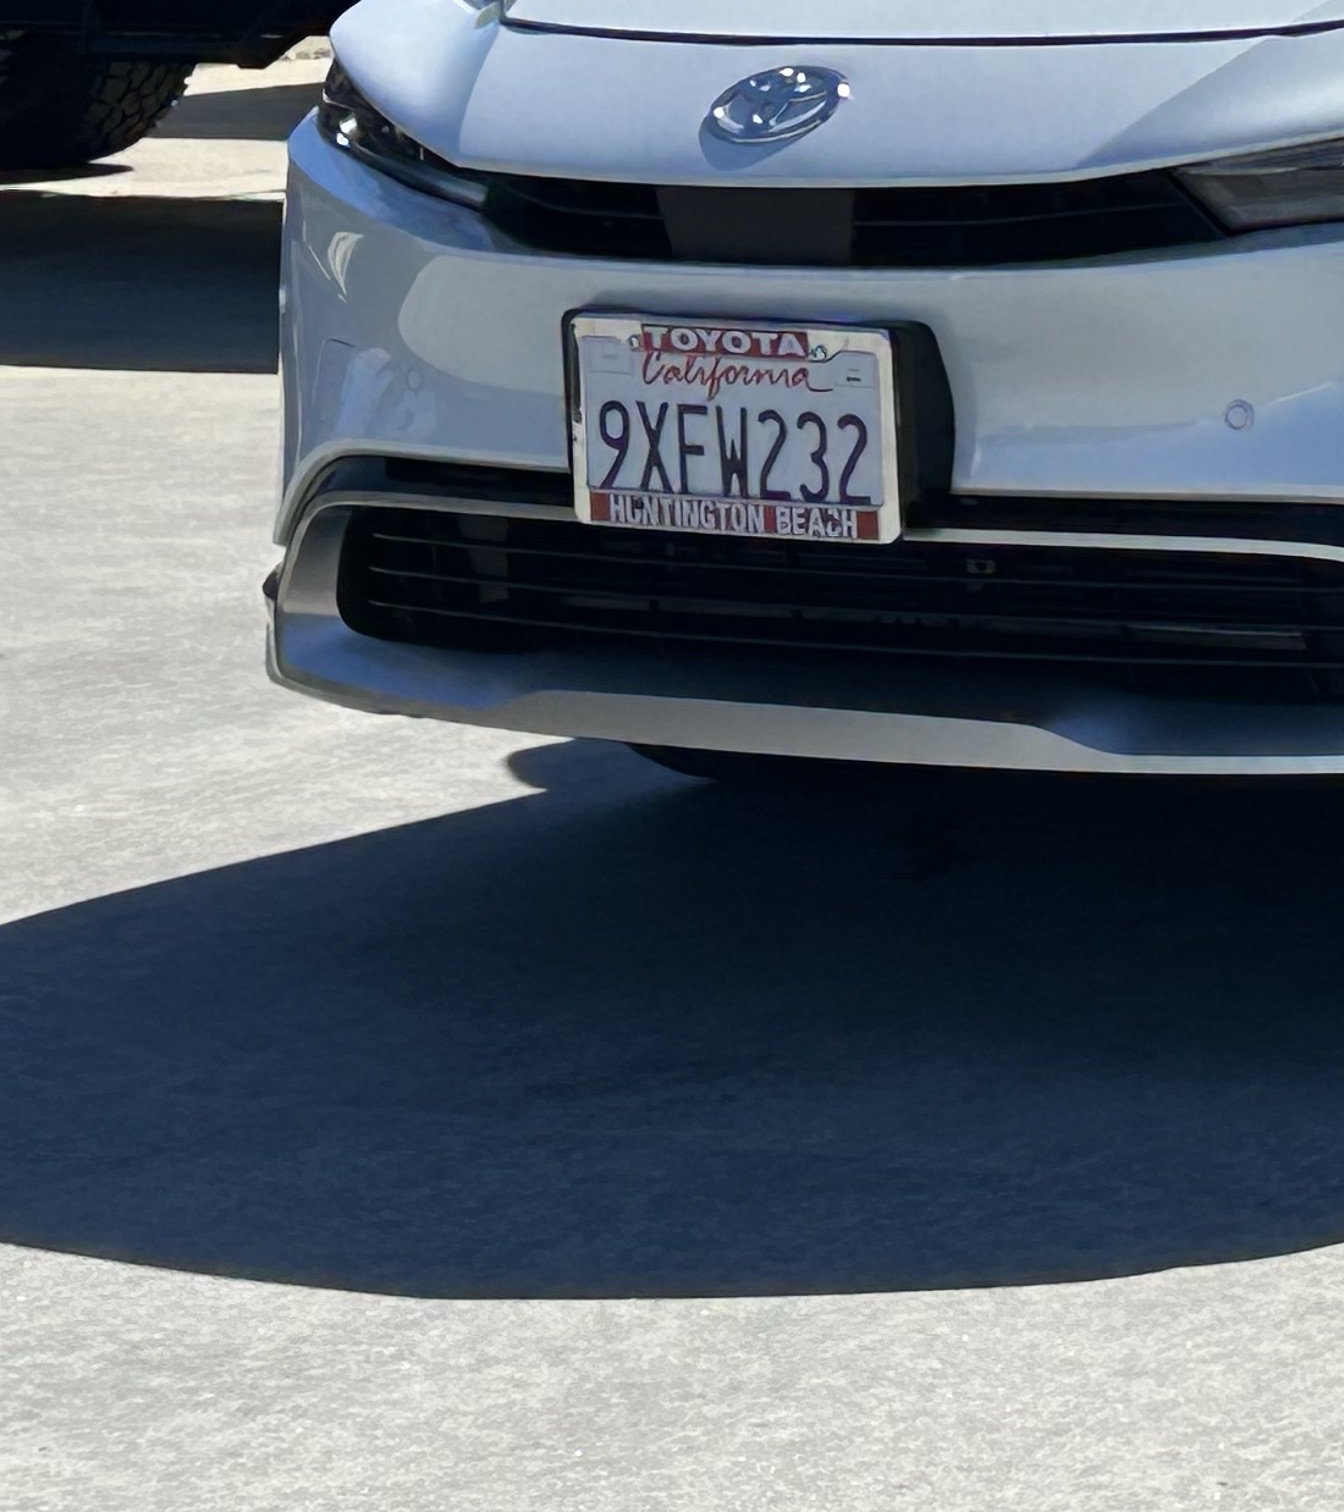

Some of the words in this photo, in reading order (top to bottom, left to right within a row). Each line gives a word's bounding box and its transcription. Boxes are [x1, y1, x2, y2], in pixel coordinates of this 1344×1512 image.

[642, 326, 806, 359] TOYOTA
[641, 349, 834, 402] California
[599, 399, 873, 506] 9XFW232
[608, 493, 765, 534] HUNTINGTON
[775, 505, 858, 539] BEACH
